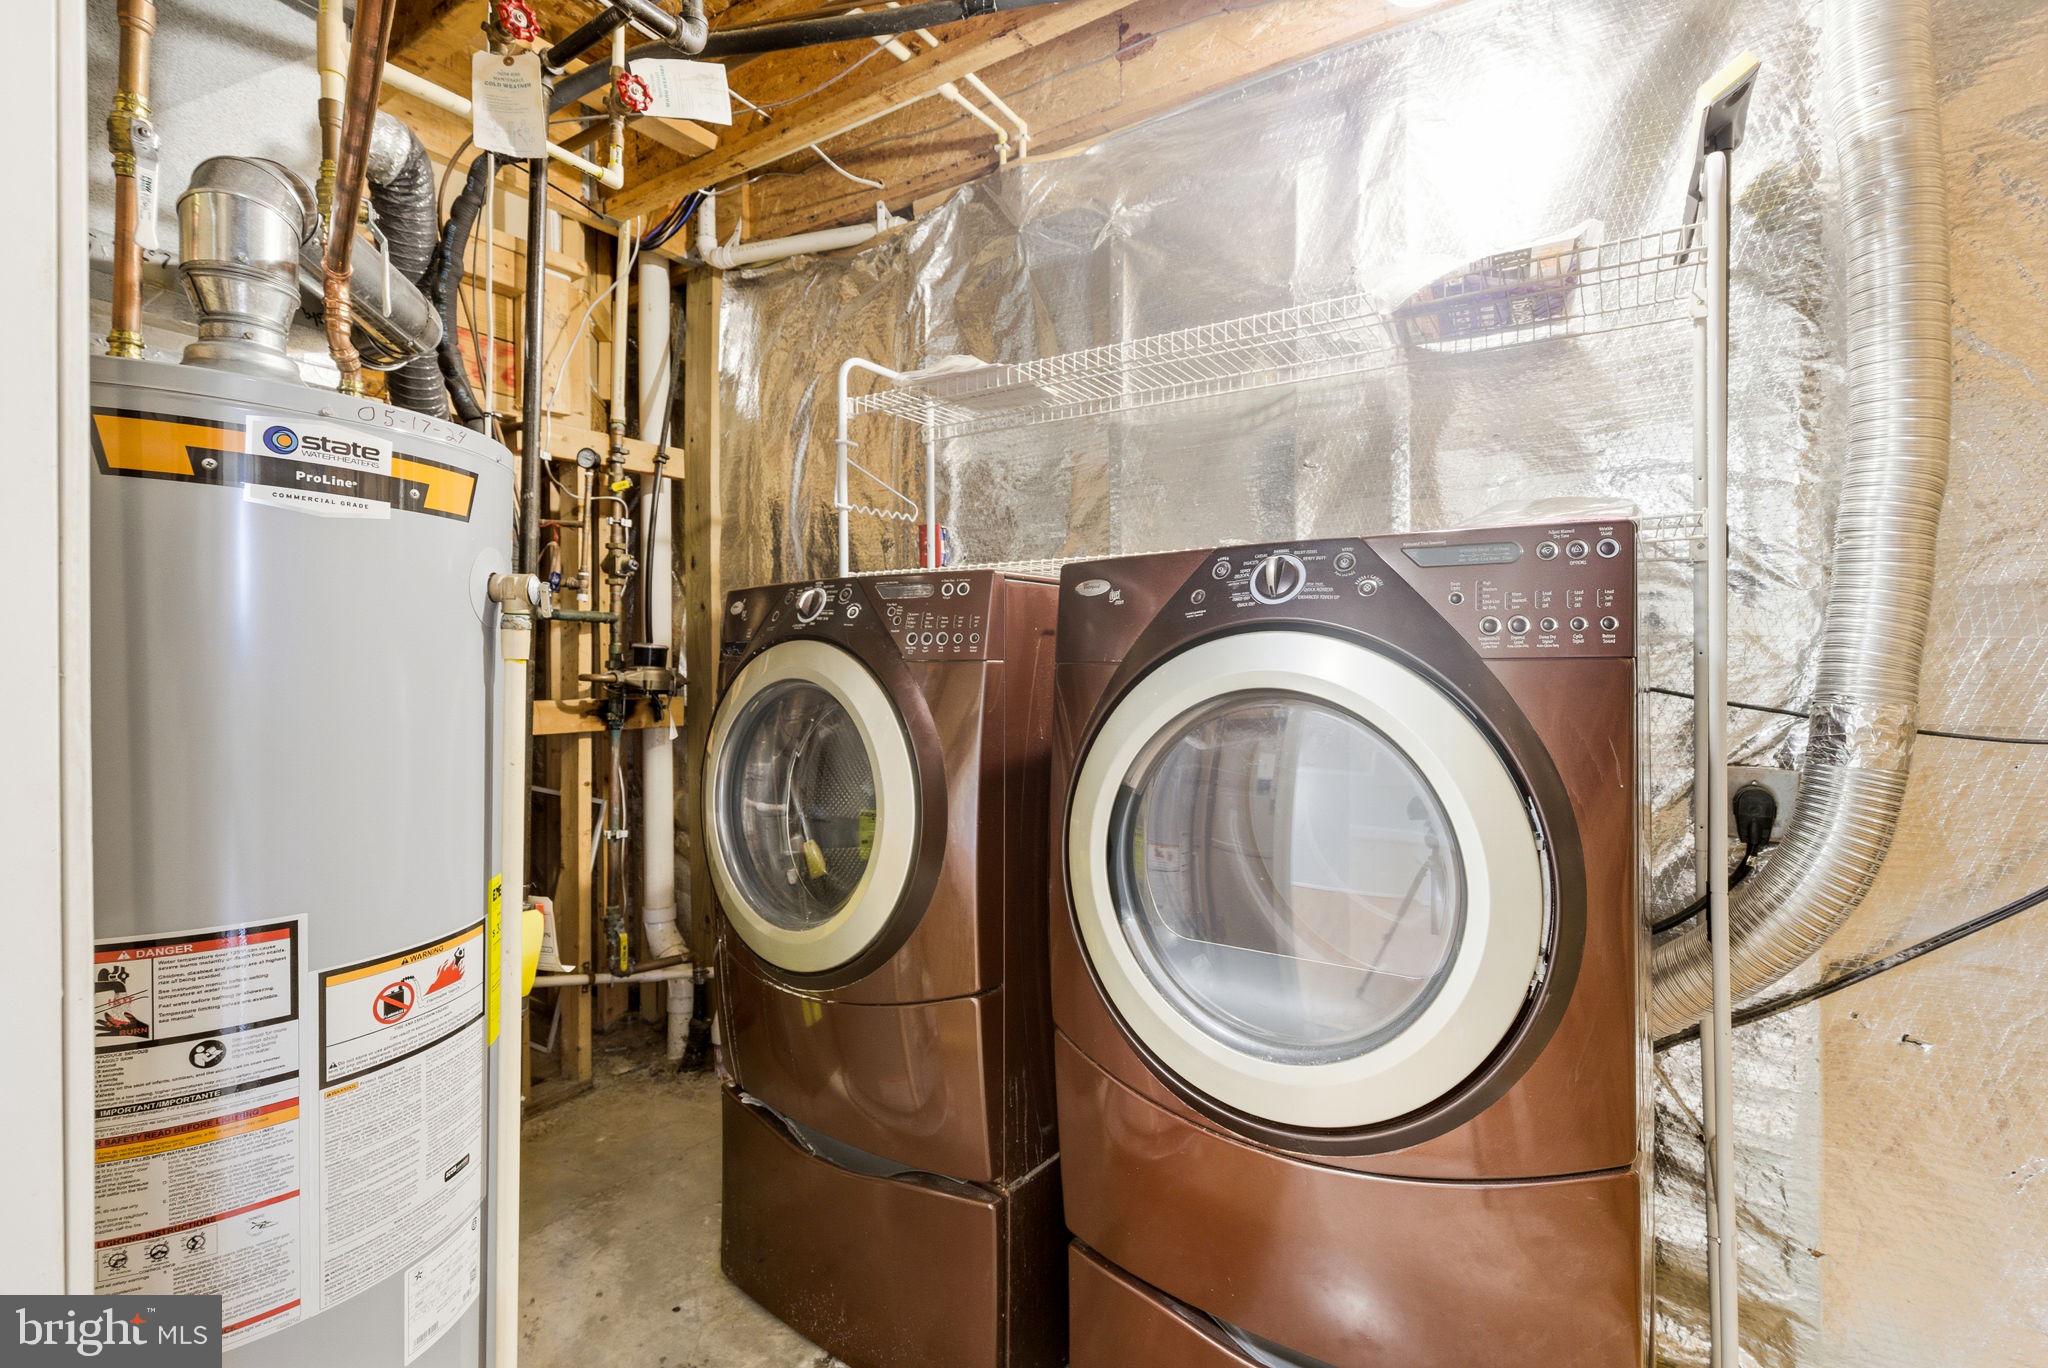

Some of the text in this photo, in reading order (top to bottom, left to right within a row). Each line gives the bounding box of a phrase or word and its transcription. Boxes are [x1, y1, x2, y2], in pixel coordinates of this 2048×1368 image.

[302, 435, 380, 461] state
[302, 450, 380, 469] WATER HEATERS
[271, 492, 369, 510] COMMERCIAL GRADE
[136, 944, 193, 959] DANGER
[177, 955, 214, 964] temperature
[409, 945, 444, 962] WARNING
[186, 967, 214, 977] disabled
[158, 990, 196, 1000] temperature
[158, 1007, 197, 1018] Temperature
[119, 1027, 148, 1037] BURN
[99, 1090, 222, 1117] IMPORTANT/IMPORTANTE
[104, 1133, 143, 1148] SAFETY
[144, 1128, 171, 1140] READ
[174, 1119, 215, 1134] BEFORE
[142, 1218, 217, 1240] INSTRUCTIONS
